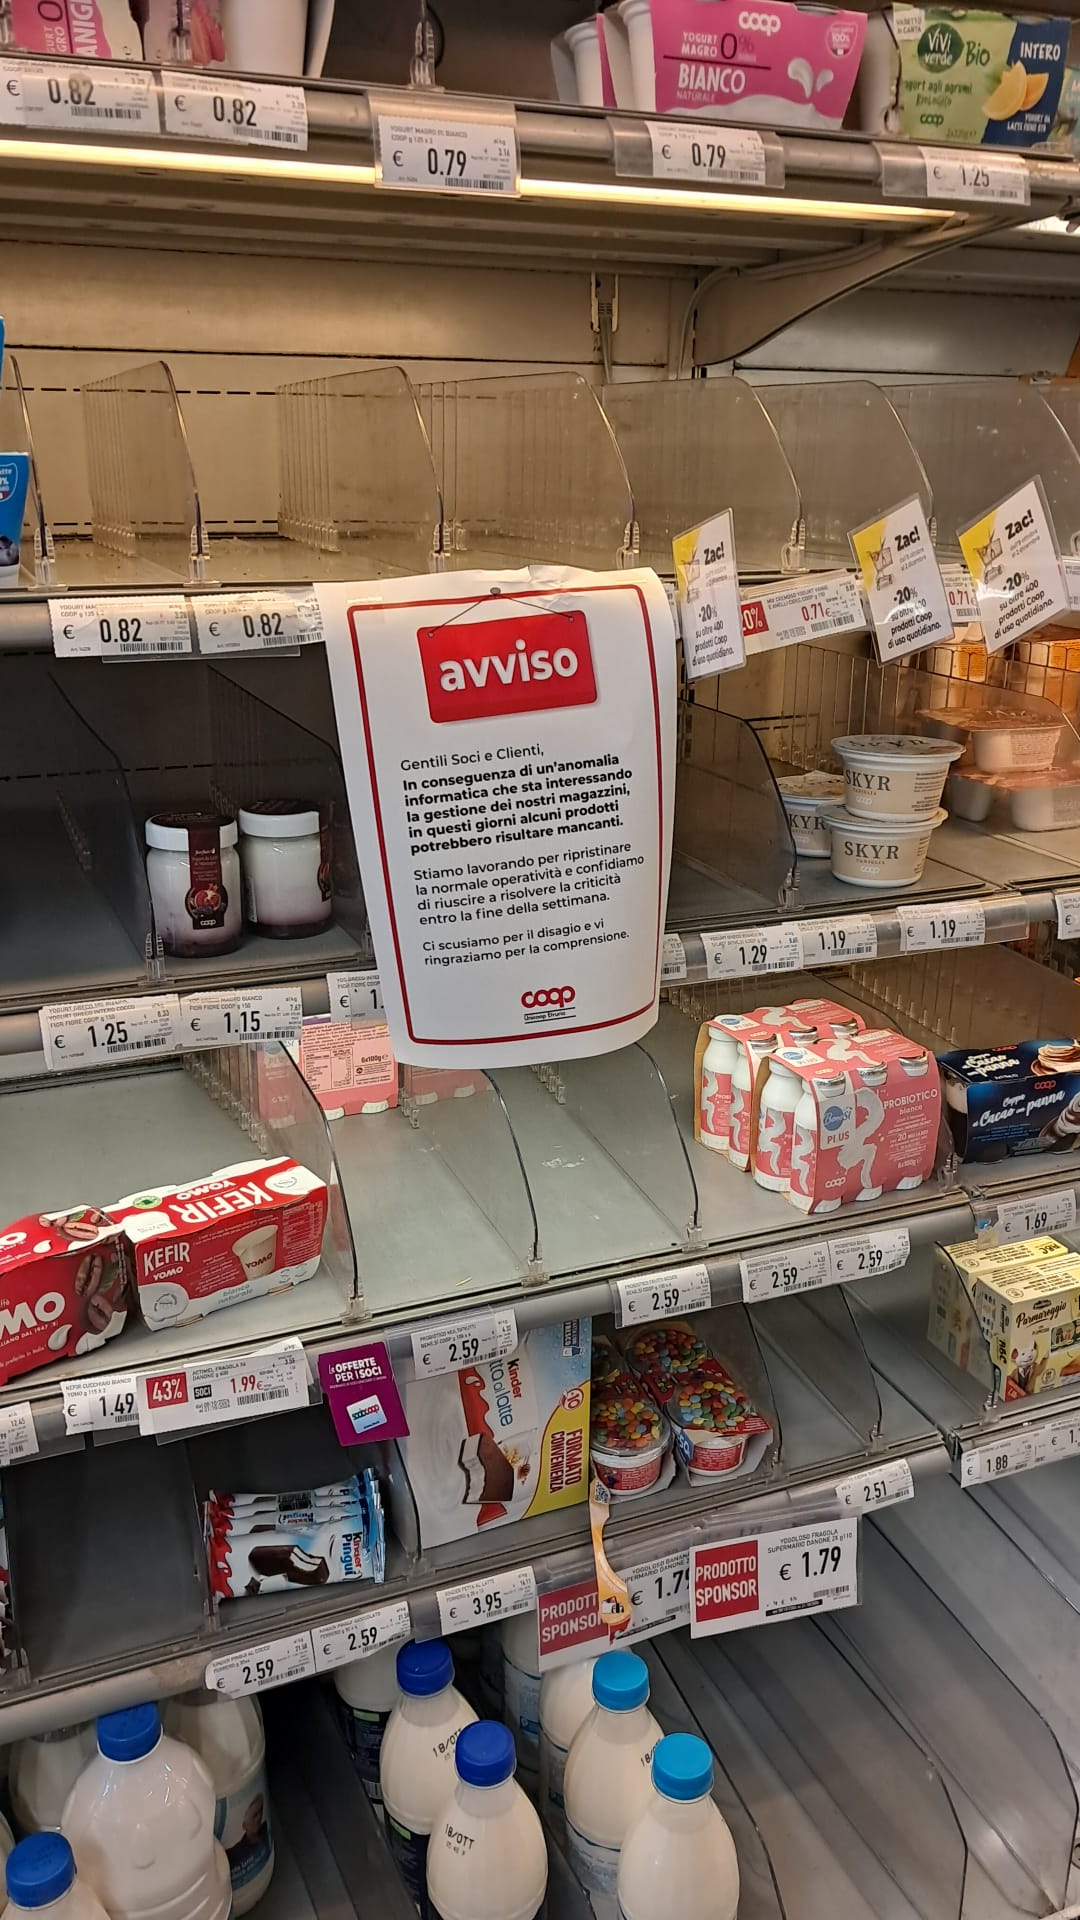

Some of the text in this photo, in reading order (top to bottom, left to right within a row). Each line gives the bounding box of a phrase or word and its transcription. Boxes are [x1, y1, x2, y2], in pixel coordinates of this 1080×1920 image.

[738, 11, 781, 37] coop
[681, 43, 718, 58] MAGRO
[683, 31, 718, 45] YOGURT
[1020, 41, 1061, 61] INTERO
[924, 50, 953, 66] verde
[965, 40, 991, 67] Bio
[47, 77, 96, 106] 0.82
[678, 63, 746, 94] BIANCO
[676, 90, 716, 103] NATURALE
[213, 95, 257, 127] 0.82
[920, 113, 944, 128] coop
[427, 147, 467, 177] 0.79
[691, 143, 726, 169] 0.79
[960, 166, 990, 188] 1.25
[1004, 508, 1035, 540] Zac!
[894, 525, 921, 552] Zac!
[703, 541, 725, 566] Zac!
[998, 590, 1045, 627] prodotti Coop
[999, 601, 1009, 612] su
[1025, 579, 1039, 594] 400
[99, 618, 143, 643] 0.82
[242, 612, 284, 638] 0.82
[890, 611, 933, 638] prodotti Coop
[994, 598, 1054, 640] di uso quotidiano.
[714, 634, 728, 646] Coop
[887, 621, 942, 649] di uso quotidiano.
[439, 639, 579, 693] avviso
[400, 743, 545, 771] Gentili Soci e Clienti,
[403, 753, 620, 792] In conseguenza di un'anomalia
[845, 769, 892, 792] SKYR
[404, 768, 633, 807] informatica che sta interessando
[406, 783, 631, 824] la gestione dei nostri magazzini,
[408, 800, 620, 839] in questi giorni alcuni prodotti
[410, 815, 624, 857] potrebbero risultare mancanti.
[413, 841, 632, 881] Stiamo lavorando per ripristinare
[844, 841, 900, 860] SKYR
[415, 854, 645, 896] la normale operatività e confidiamo
[417, 873, 622, 911] di riuscire a risolvere la criticità
[419, 892, 611, 926] entro la fine della settimana.
[422, 918, 605, 952] Ci scusiamo per il disagio e vi
[818, 929, 846, 951] 1.19
[930, 919, 956, 939] 1.19
[424, 932, 630, 968] ringraziamo per la comprensione.
[739, 944, 768, 966] 1.29
[520, 985, 576, 1009] coop
[87, 1020, 128, 1048] 1.25
[223, 1010, 260, 1034] 1.15
[1034, 1080, 1057, 1090] coop
[883, 1088, 938, 1110] PROBIOTICO
[1025, 1090, 1066, 1117] panna
[980, 1108, 1016, 1127] Cacao
[176, 1179, 237, 1200] YOMO
[824, 1176, 846, 1188] coop
[168, 1181, 274, 1224] KEFIR
[1024, 1210, 1048, 1232] 1.69
[143, 1241, 191, 1277] KEFIR
[244, 1252, 273, 1270] YOMO
[858, 1249, 883, 1270] 2.59
[153, 1266, 184, 1282] YOMO
[771, 1266, 798, 1289] 2.59
[651, 1288, 680, 1311] 2.59
[1015, 1301, 1067, 1329] Parmareggio
[448, 1337, 479, 1363] 2.59
[335, 1356, 377, 1373] OFFERTE
[335, 1371, 354, 1384] PER
[359, 1365, 383, 1379] SOCI
[152, 1377, 183, 1402] 43%
[507, 1357, 523, 1399] Kinder
[98, 1392, 135, 1417] 1.49
[194, 1386, 212, 1398] SOCI
[496, 1389, 514, 1427] latte
[549, 1430, 565, 1494] CONVENIENZA
[565, 1428, 583, 1487] FORMATO
[986, 1454, 1008, 1473] 1.88
[863, 1479, 887, 1502] 2.51
[767, 1537, 831, 1554] SUPERMARIO DANONE
[780, 1528, 838, 1544] YOGOLOSO FRAGOLA
[352, 1531, 363, 1568] Kinder
[802, 1546, 842, 1578] 1.79
[632, 1560, 665, 1574] YOGOLOSO
[659, 1560, 685, 1573] DANONE
[695, 1555, 756, 1582] PRODOTTO
[472, 1591, 502, 1616] 3.95
[696, 1579, 757, 1607] SPONSOR
[541, 1591, 600, 1623] PRODOTT
[347, 1626, 378, 1652] 2.59
[242, 1658, 274, 1685] 2.59
[446, 1823, 476, 1850] 18/OTT
